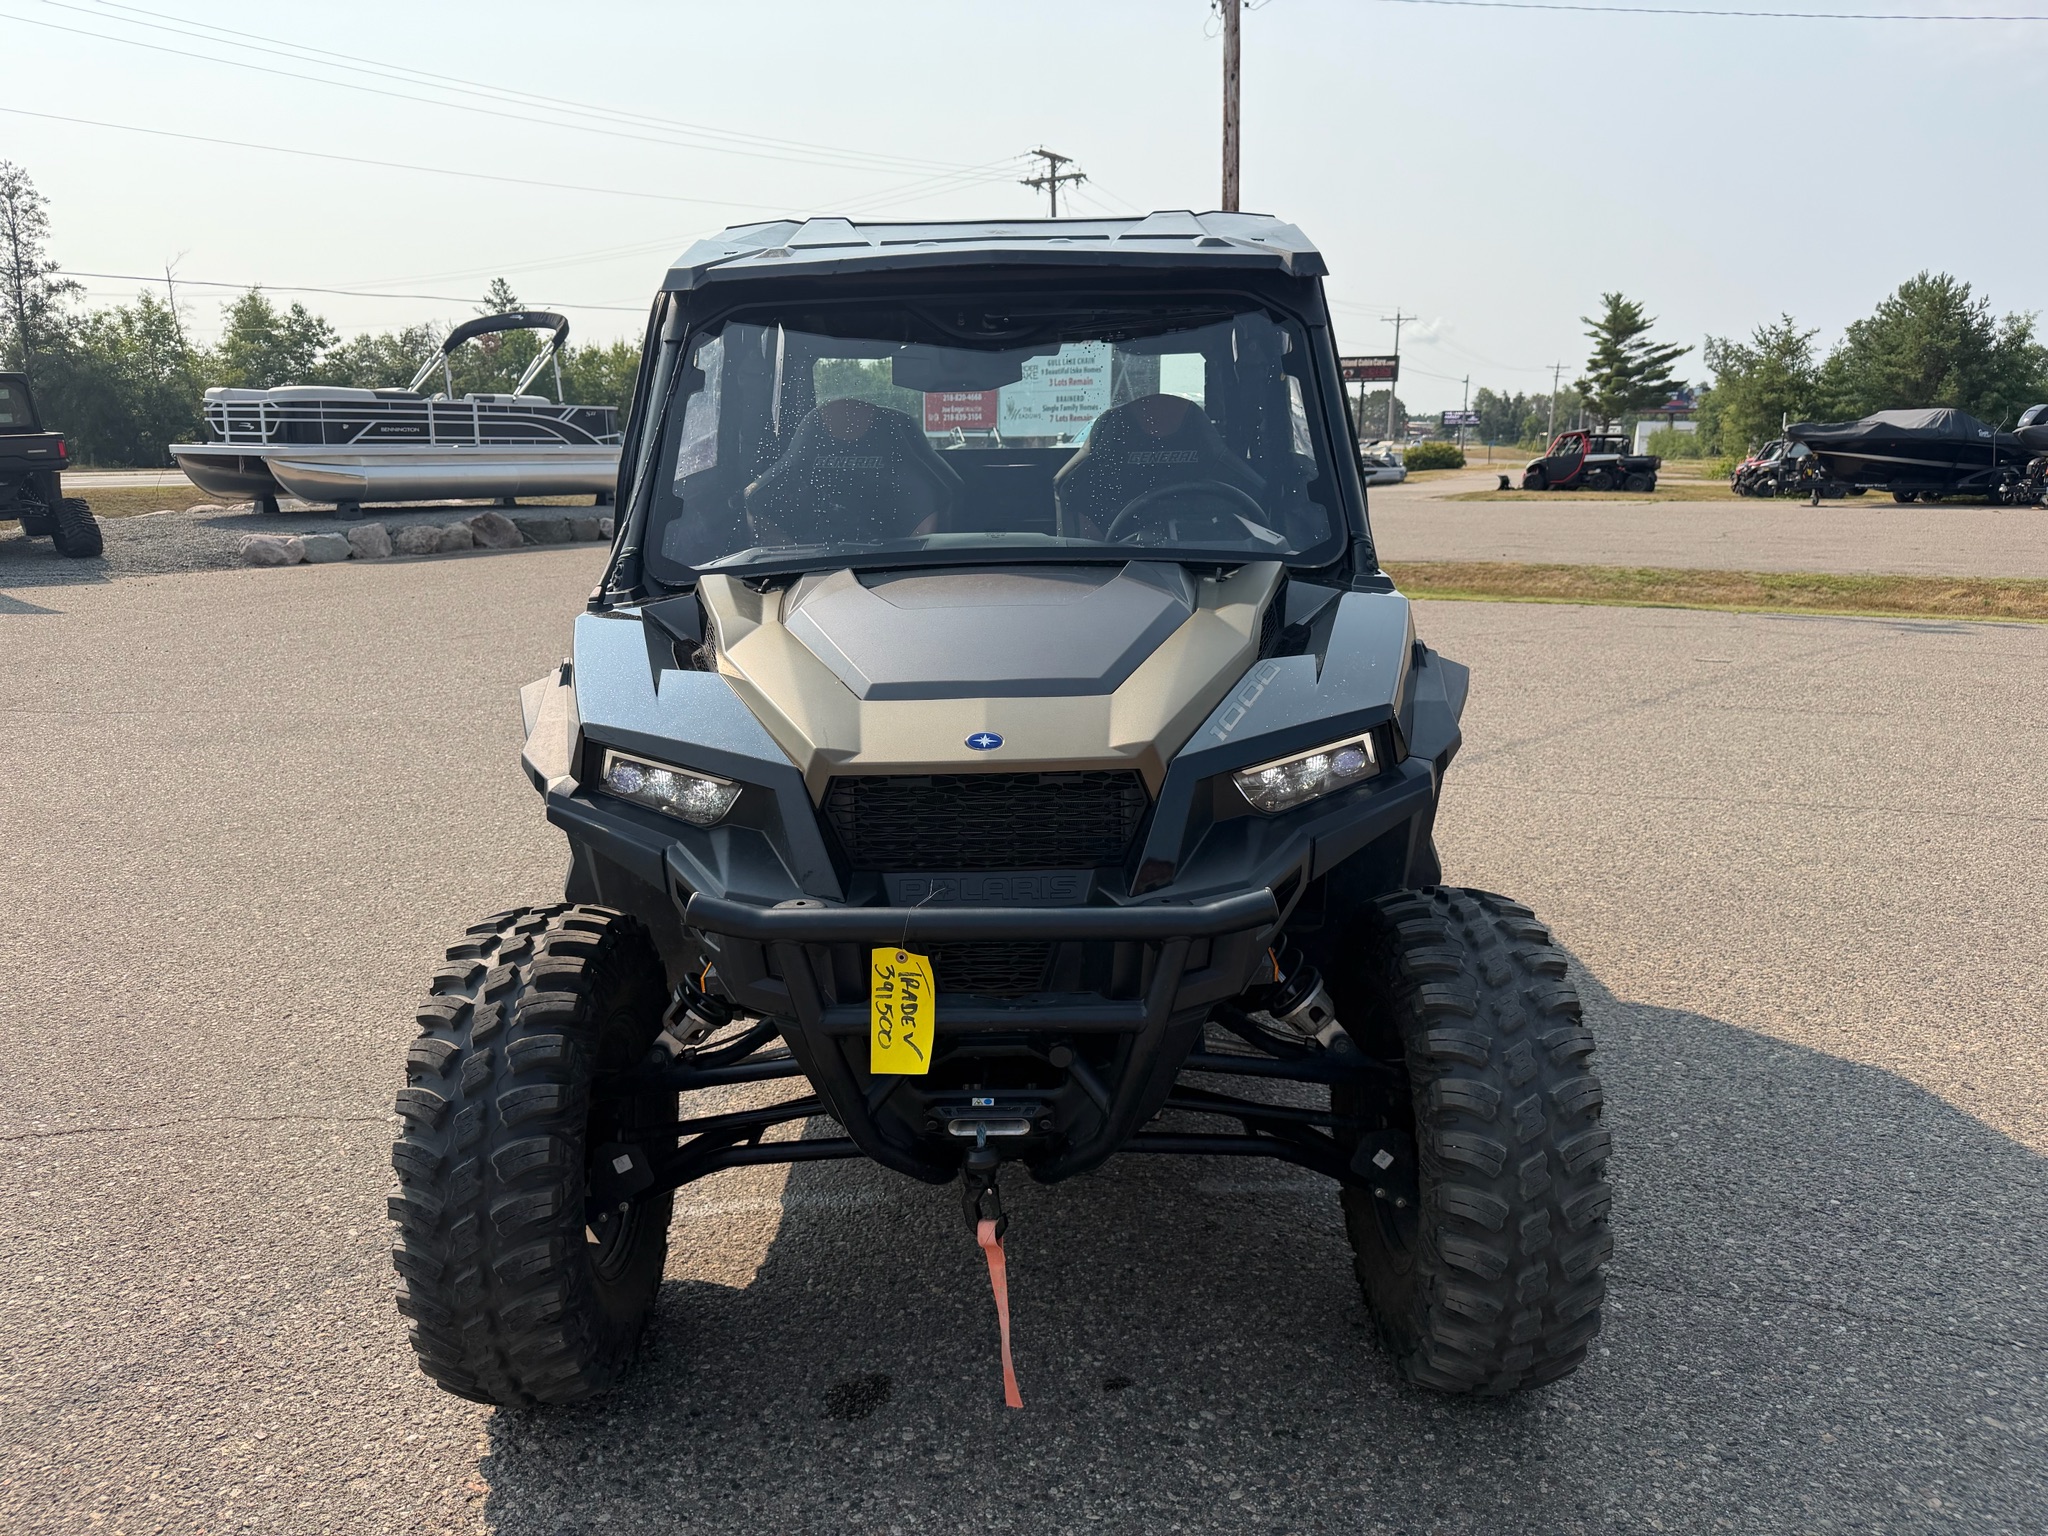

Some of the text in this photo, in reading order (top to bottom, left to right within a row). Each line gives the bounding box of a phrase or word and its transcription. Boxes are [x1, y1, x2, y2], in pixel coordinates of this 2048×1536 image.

[1054, 378, 1068, 387] Lots
[1068, 377, 1094, 386] Remain
[1042, 404, 1059, 413] Single
[1060, 403, 1078, 413] Family
[1055, 414, 1069, 422] Lots
[1069, 413, 1094, 422] Remain
[812, 456, 885, 469] GENERAL
[1127, 450, 1199, 464] GENERAL
[1209, 660, 1281, 742] 1000
[899, 876, 1078, 902] POLARIS
